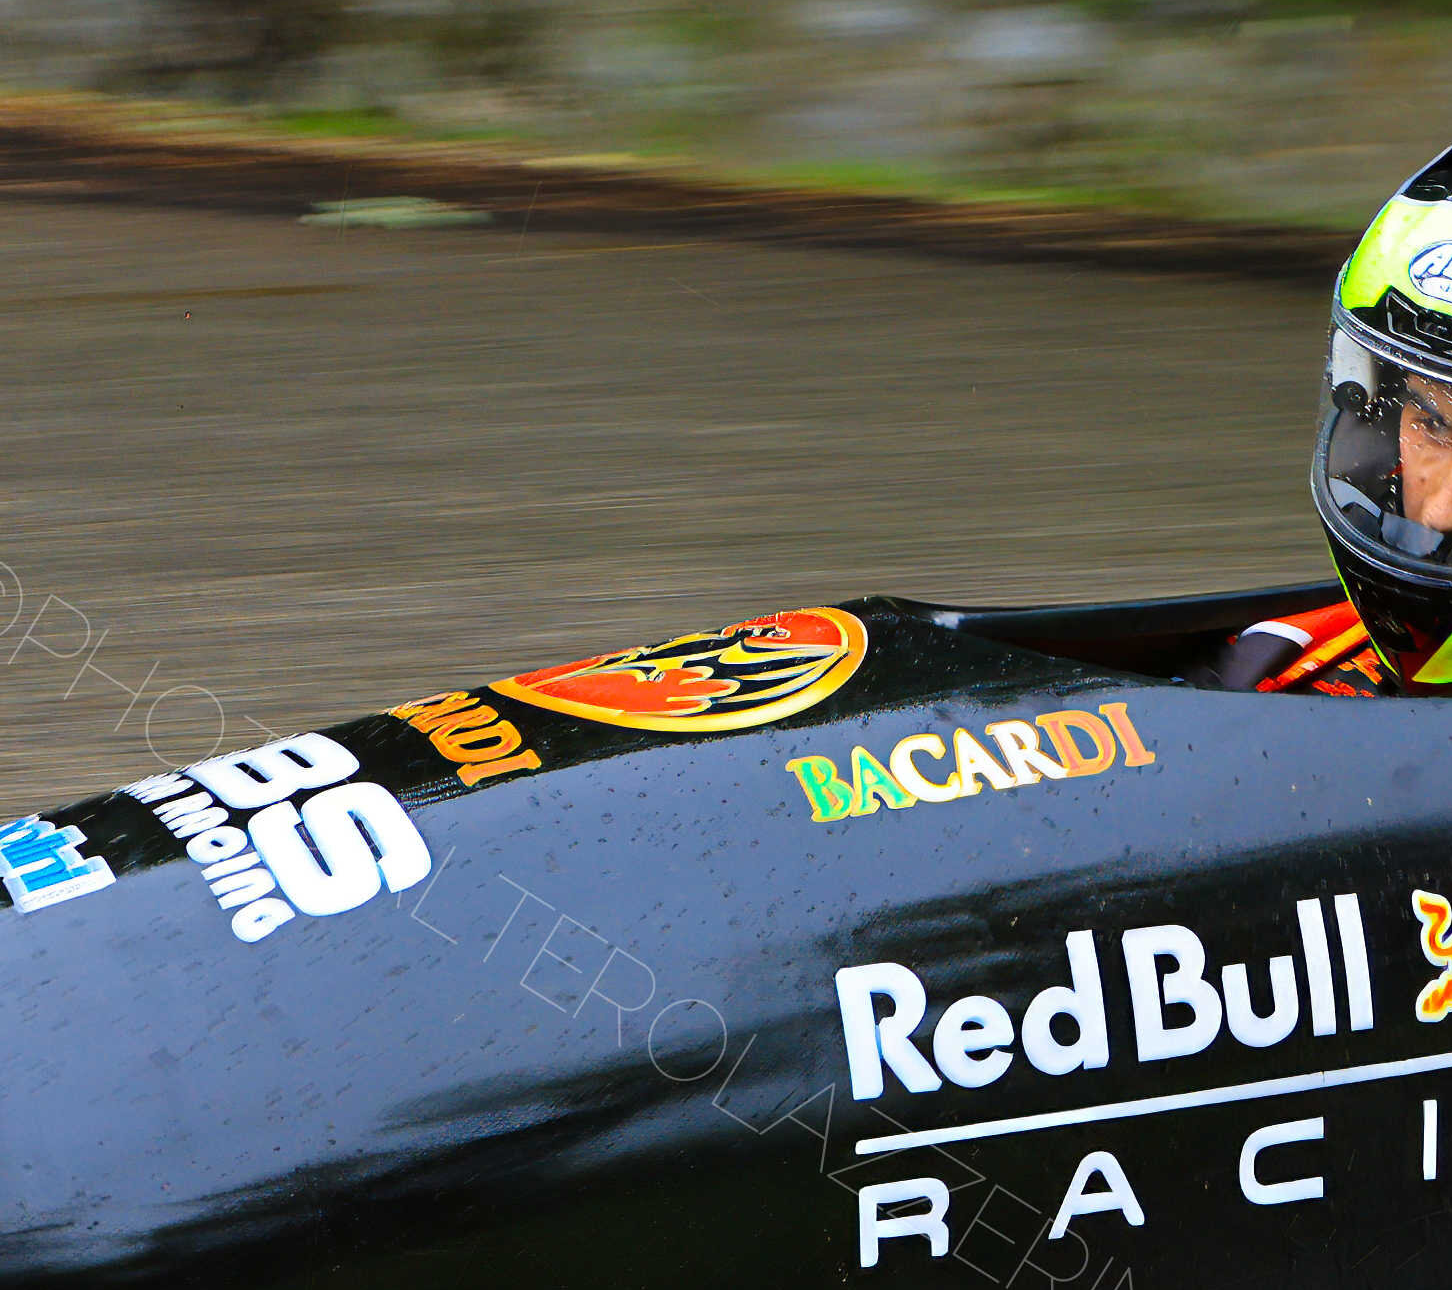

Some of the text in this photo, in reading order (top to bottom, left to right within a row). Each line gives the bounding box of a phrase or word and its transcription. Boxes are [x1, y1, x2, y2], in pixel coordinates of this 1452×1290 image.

[785, 701, 1157, 823] BACARDI
[834, 891, 1376, 1100] Red Bull
